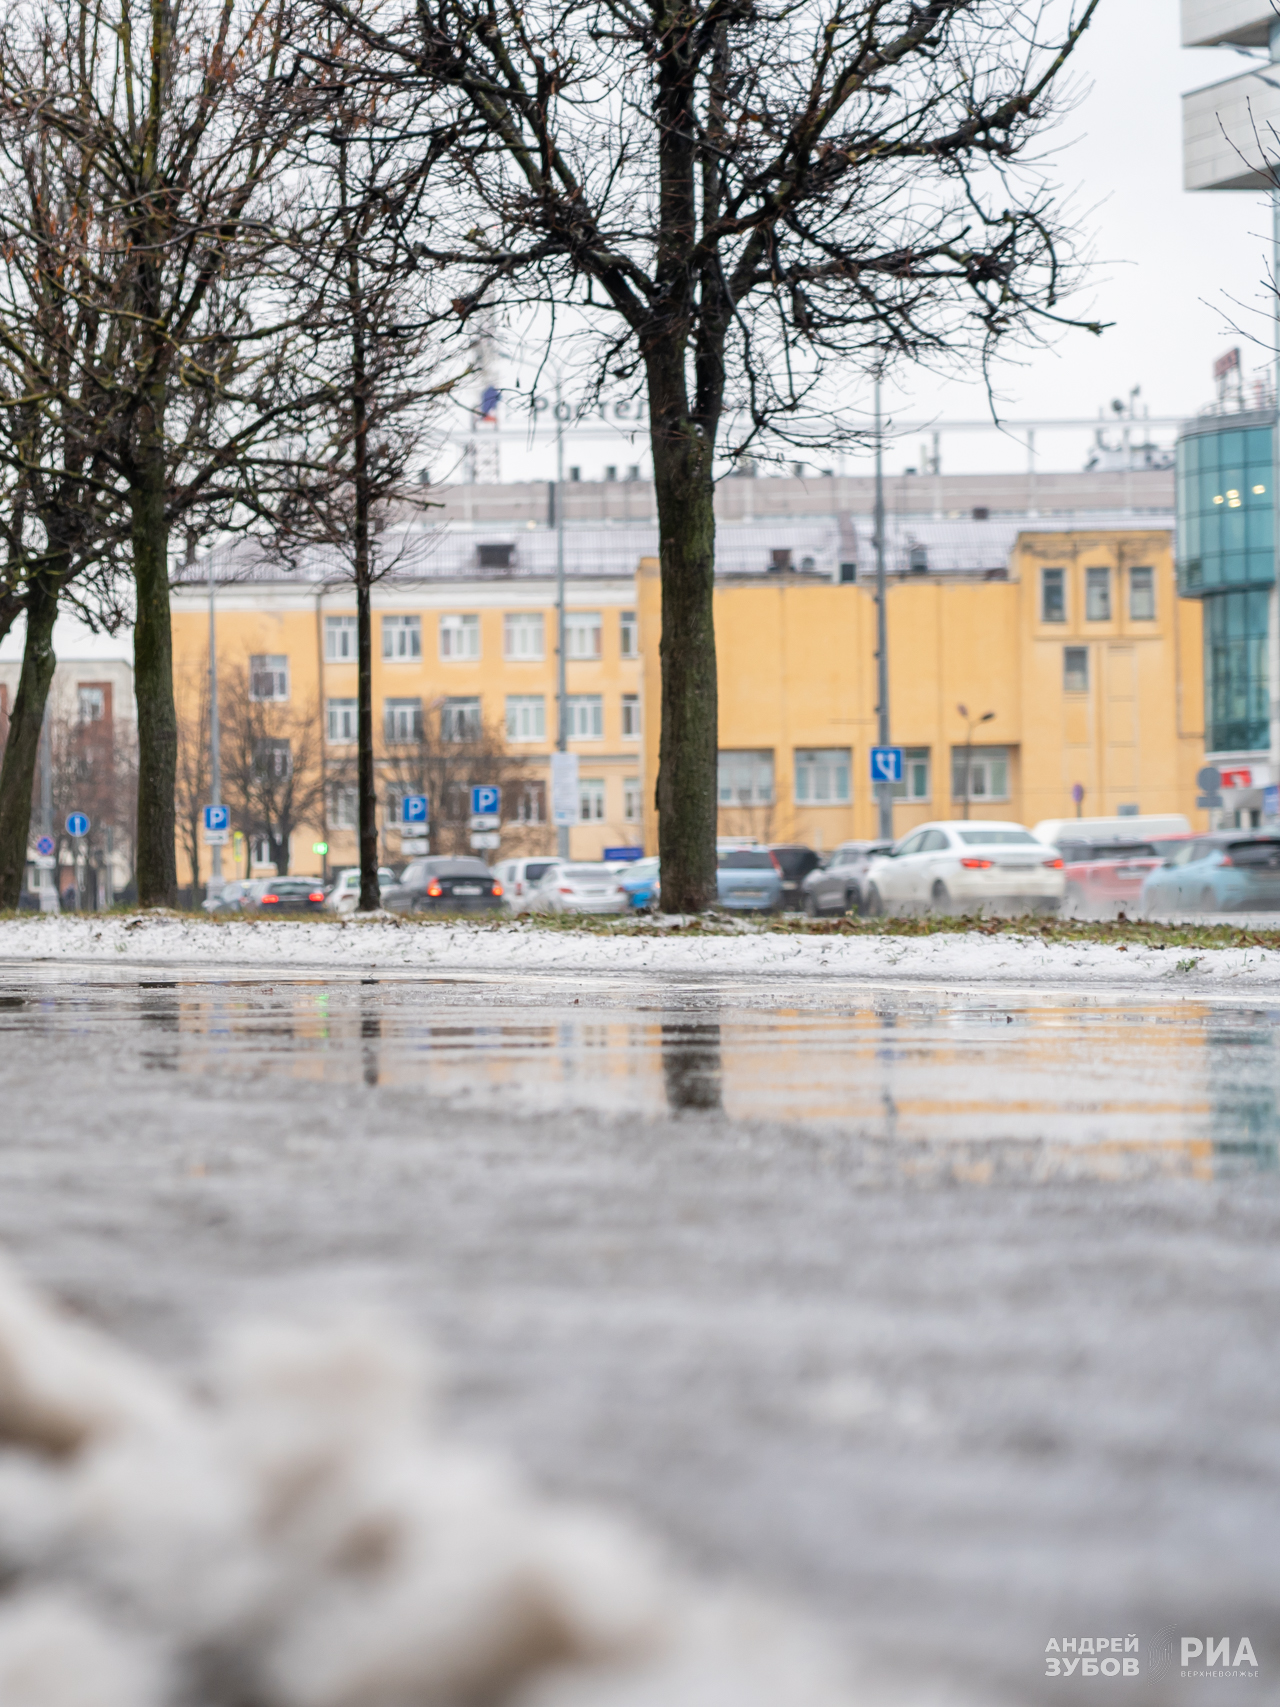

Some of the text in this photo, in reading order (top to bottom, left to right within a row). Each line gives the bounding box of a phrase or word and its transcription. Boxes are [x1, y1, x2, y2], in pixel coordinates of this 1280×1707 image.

[409, 798, 424, 820] P
[479, 788, 495, 812] P
[210, 808, 225, 828] P
